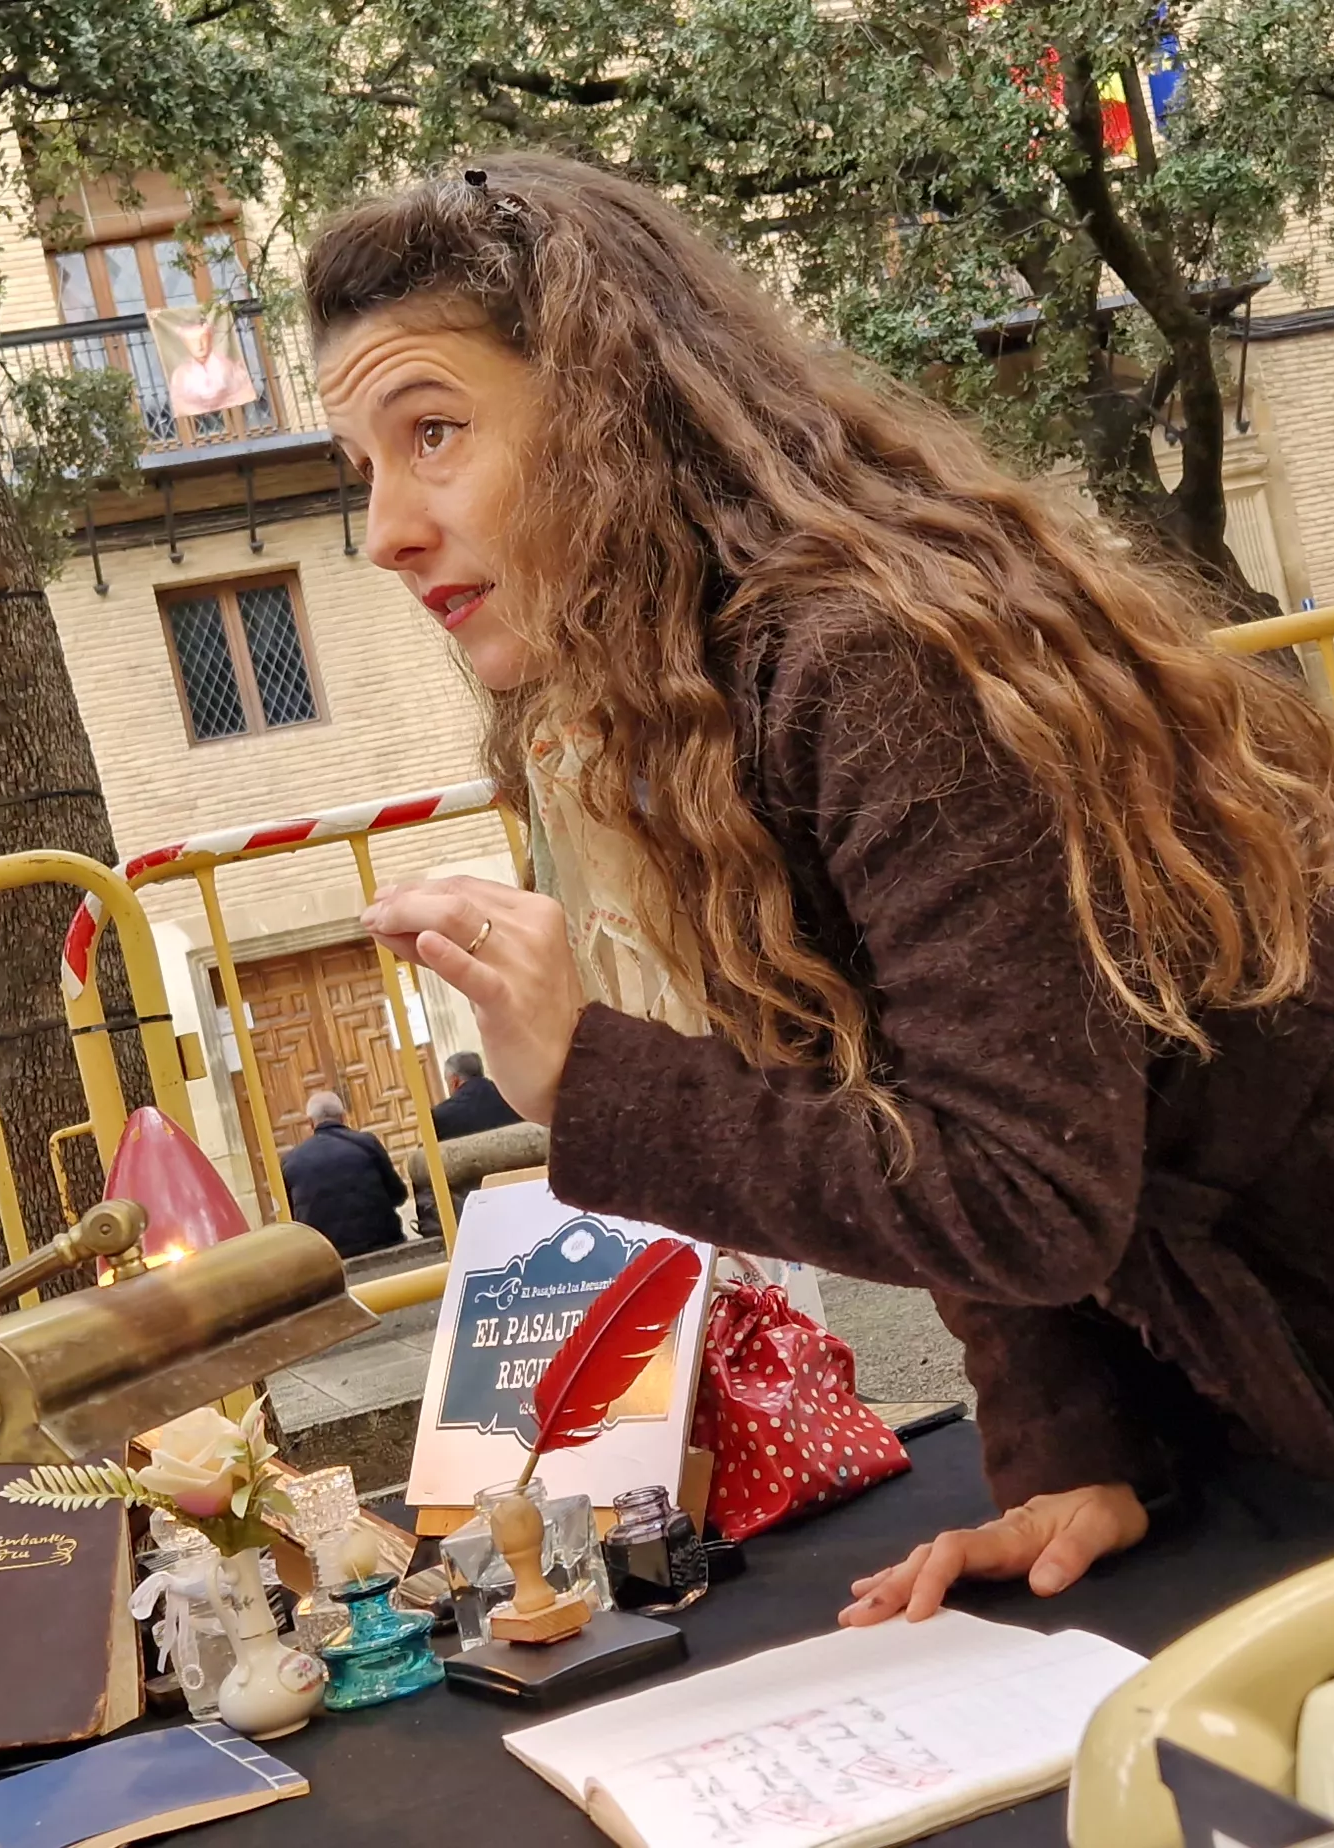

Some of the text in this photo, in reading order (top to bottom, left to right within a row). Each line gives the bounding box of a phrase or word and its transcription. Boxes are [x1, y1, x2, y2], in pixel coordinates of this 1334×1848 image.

[557, 1283, 566, 1294] de
[567, 1282, 579, 1294] los
[472, 1318, 500, 1348] EL
